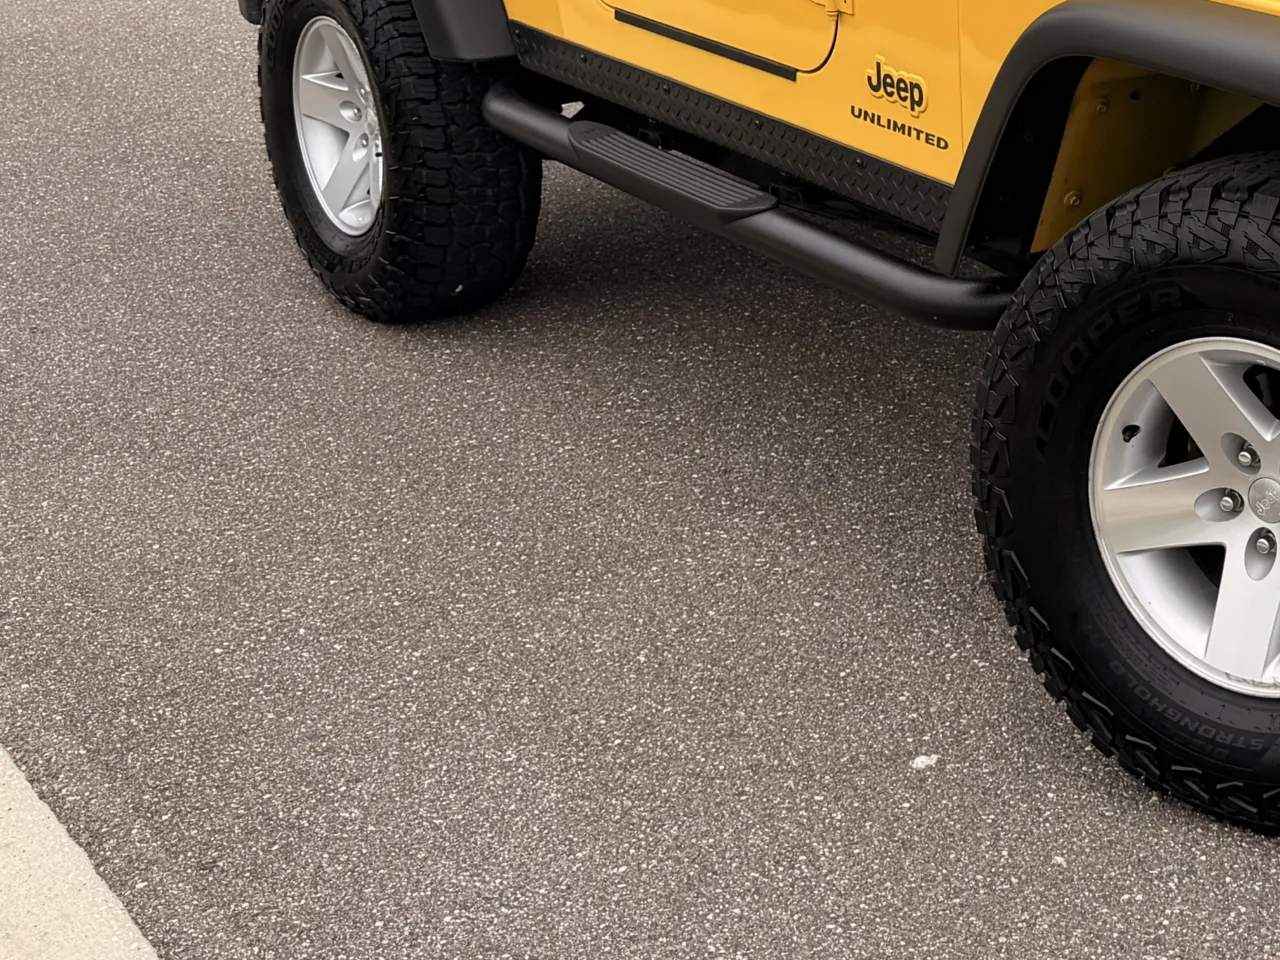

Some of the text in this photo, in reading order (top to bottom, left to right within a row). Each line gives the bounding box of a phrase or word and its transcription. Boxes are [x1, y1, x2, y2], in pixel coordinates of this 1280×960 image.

[867, 61, 924, 111] Jeep
[850, 105, 949, 150] UNLIMITED
[1037, 285, 1185, 440] COOPER
[1256, 488, 1279, 516] Jeep
[1109, 659, 1265, 771] STRONGHOLD
